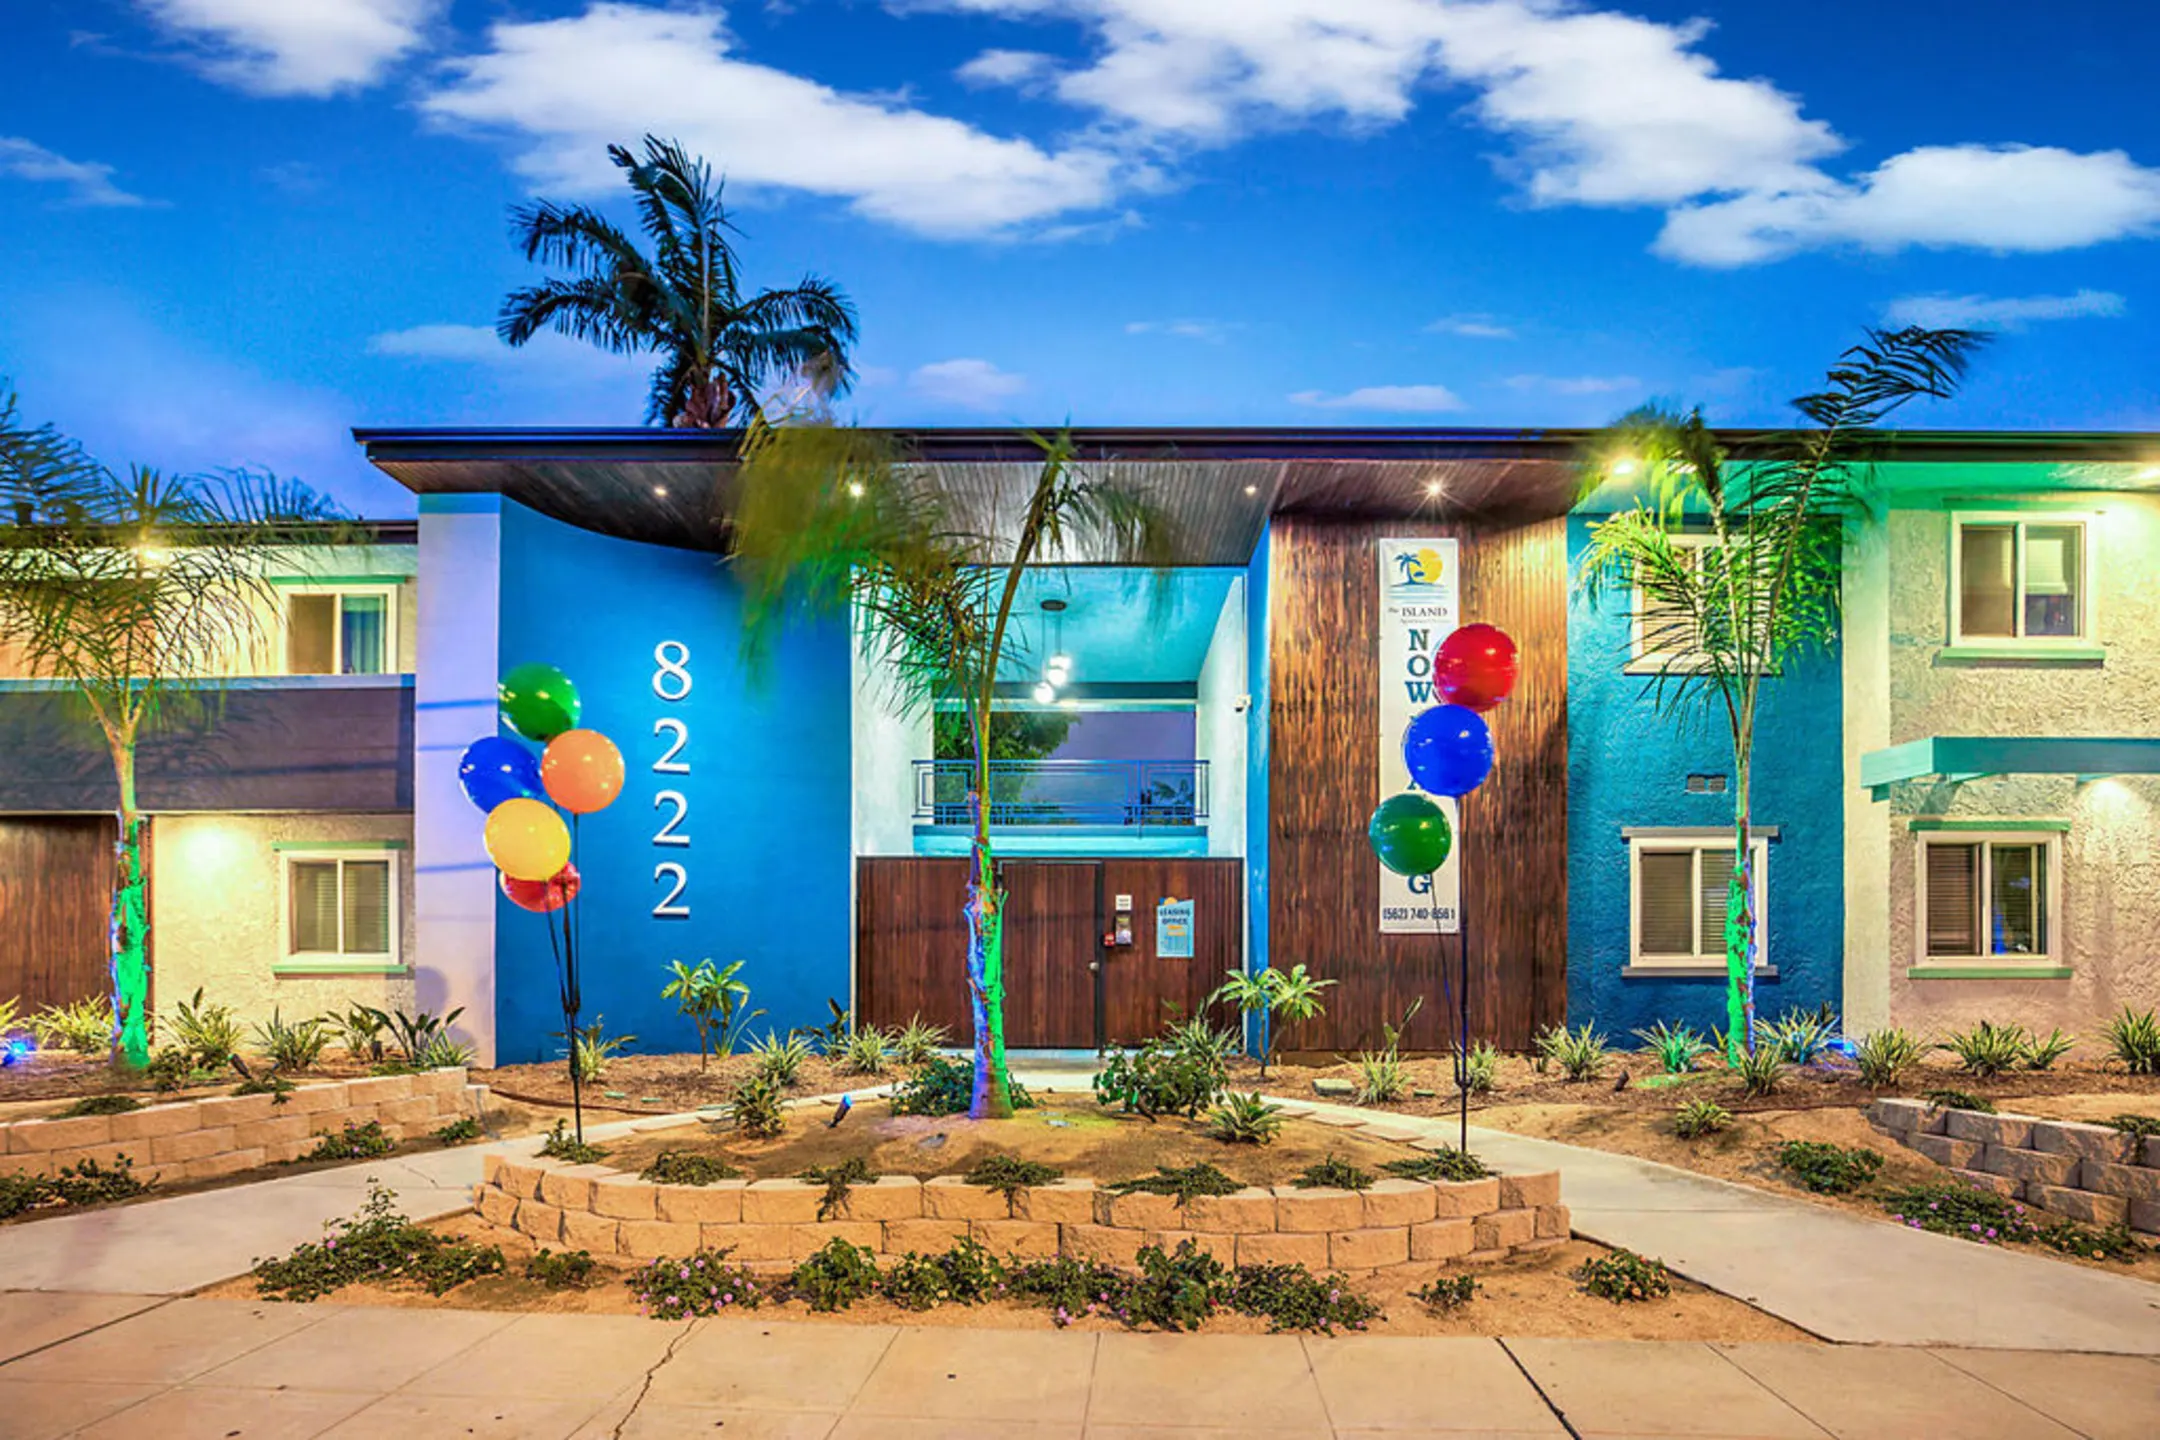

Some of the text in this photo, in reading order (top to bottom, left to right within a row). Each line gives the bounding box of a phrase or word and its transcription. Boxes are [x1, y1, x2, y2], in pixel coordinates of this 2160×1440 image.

[1402, 607, 1448, 617] ISLAND
[1405, 629, 1433, 703] NOW
[652, 640, 692, 918] 8222
